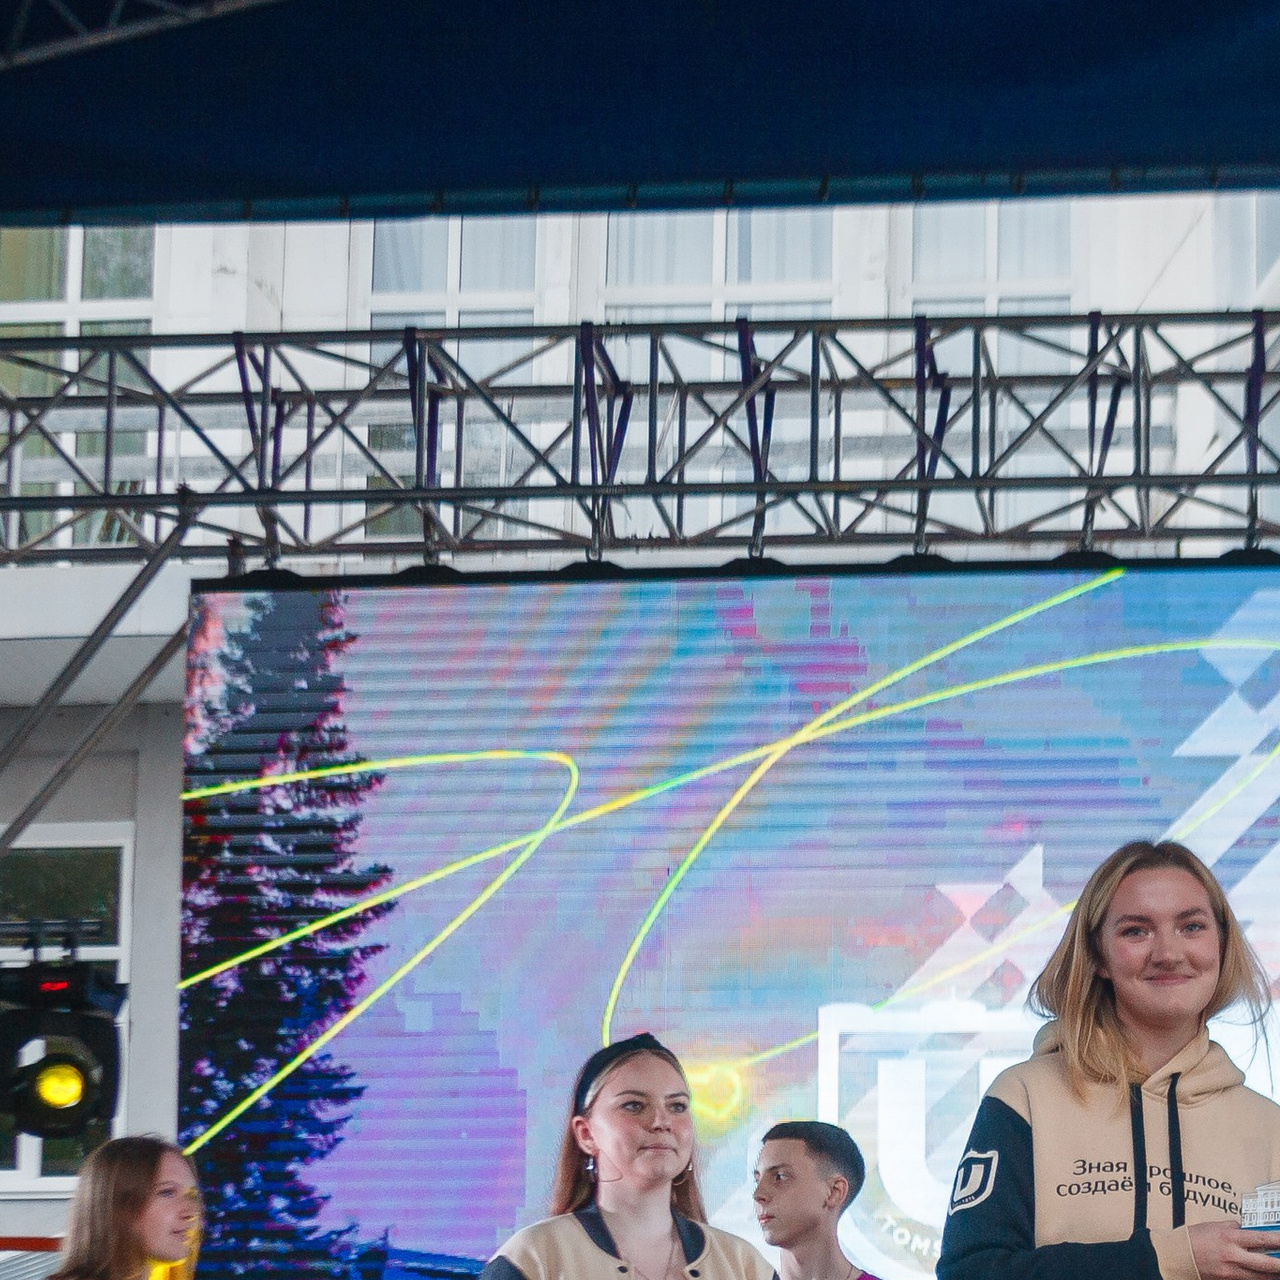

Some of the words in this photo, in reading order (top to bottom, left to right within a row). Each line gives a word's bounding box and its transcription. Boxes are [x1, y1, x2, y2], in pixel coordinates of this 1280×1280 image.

[1056, 1176, 1152, 1197] создаё
[1159, 1182, 1243, 1217] бдуще
[1072, 1159, 1128, 1176] Зная
[1147, 1164, 1238, 1198] рошлое,
